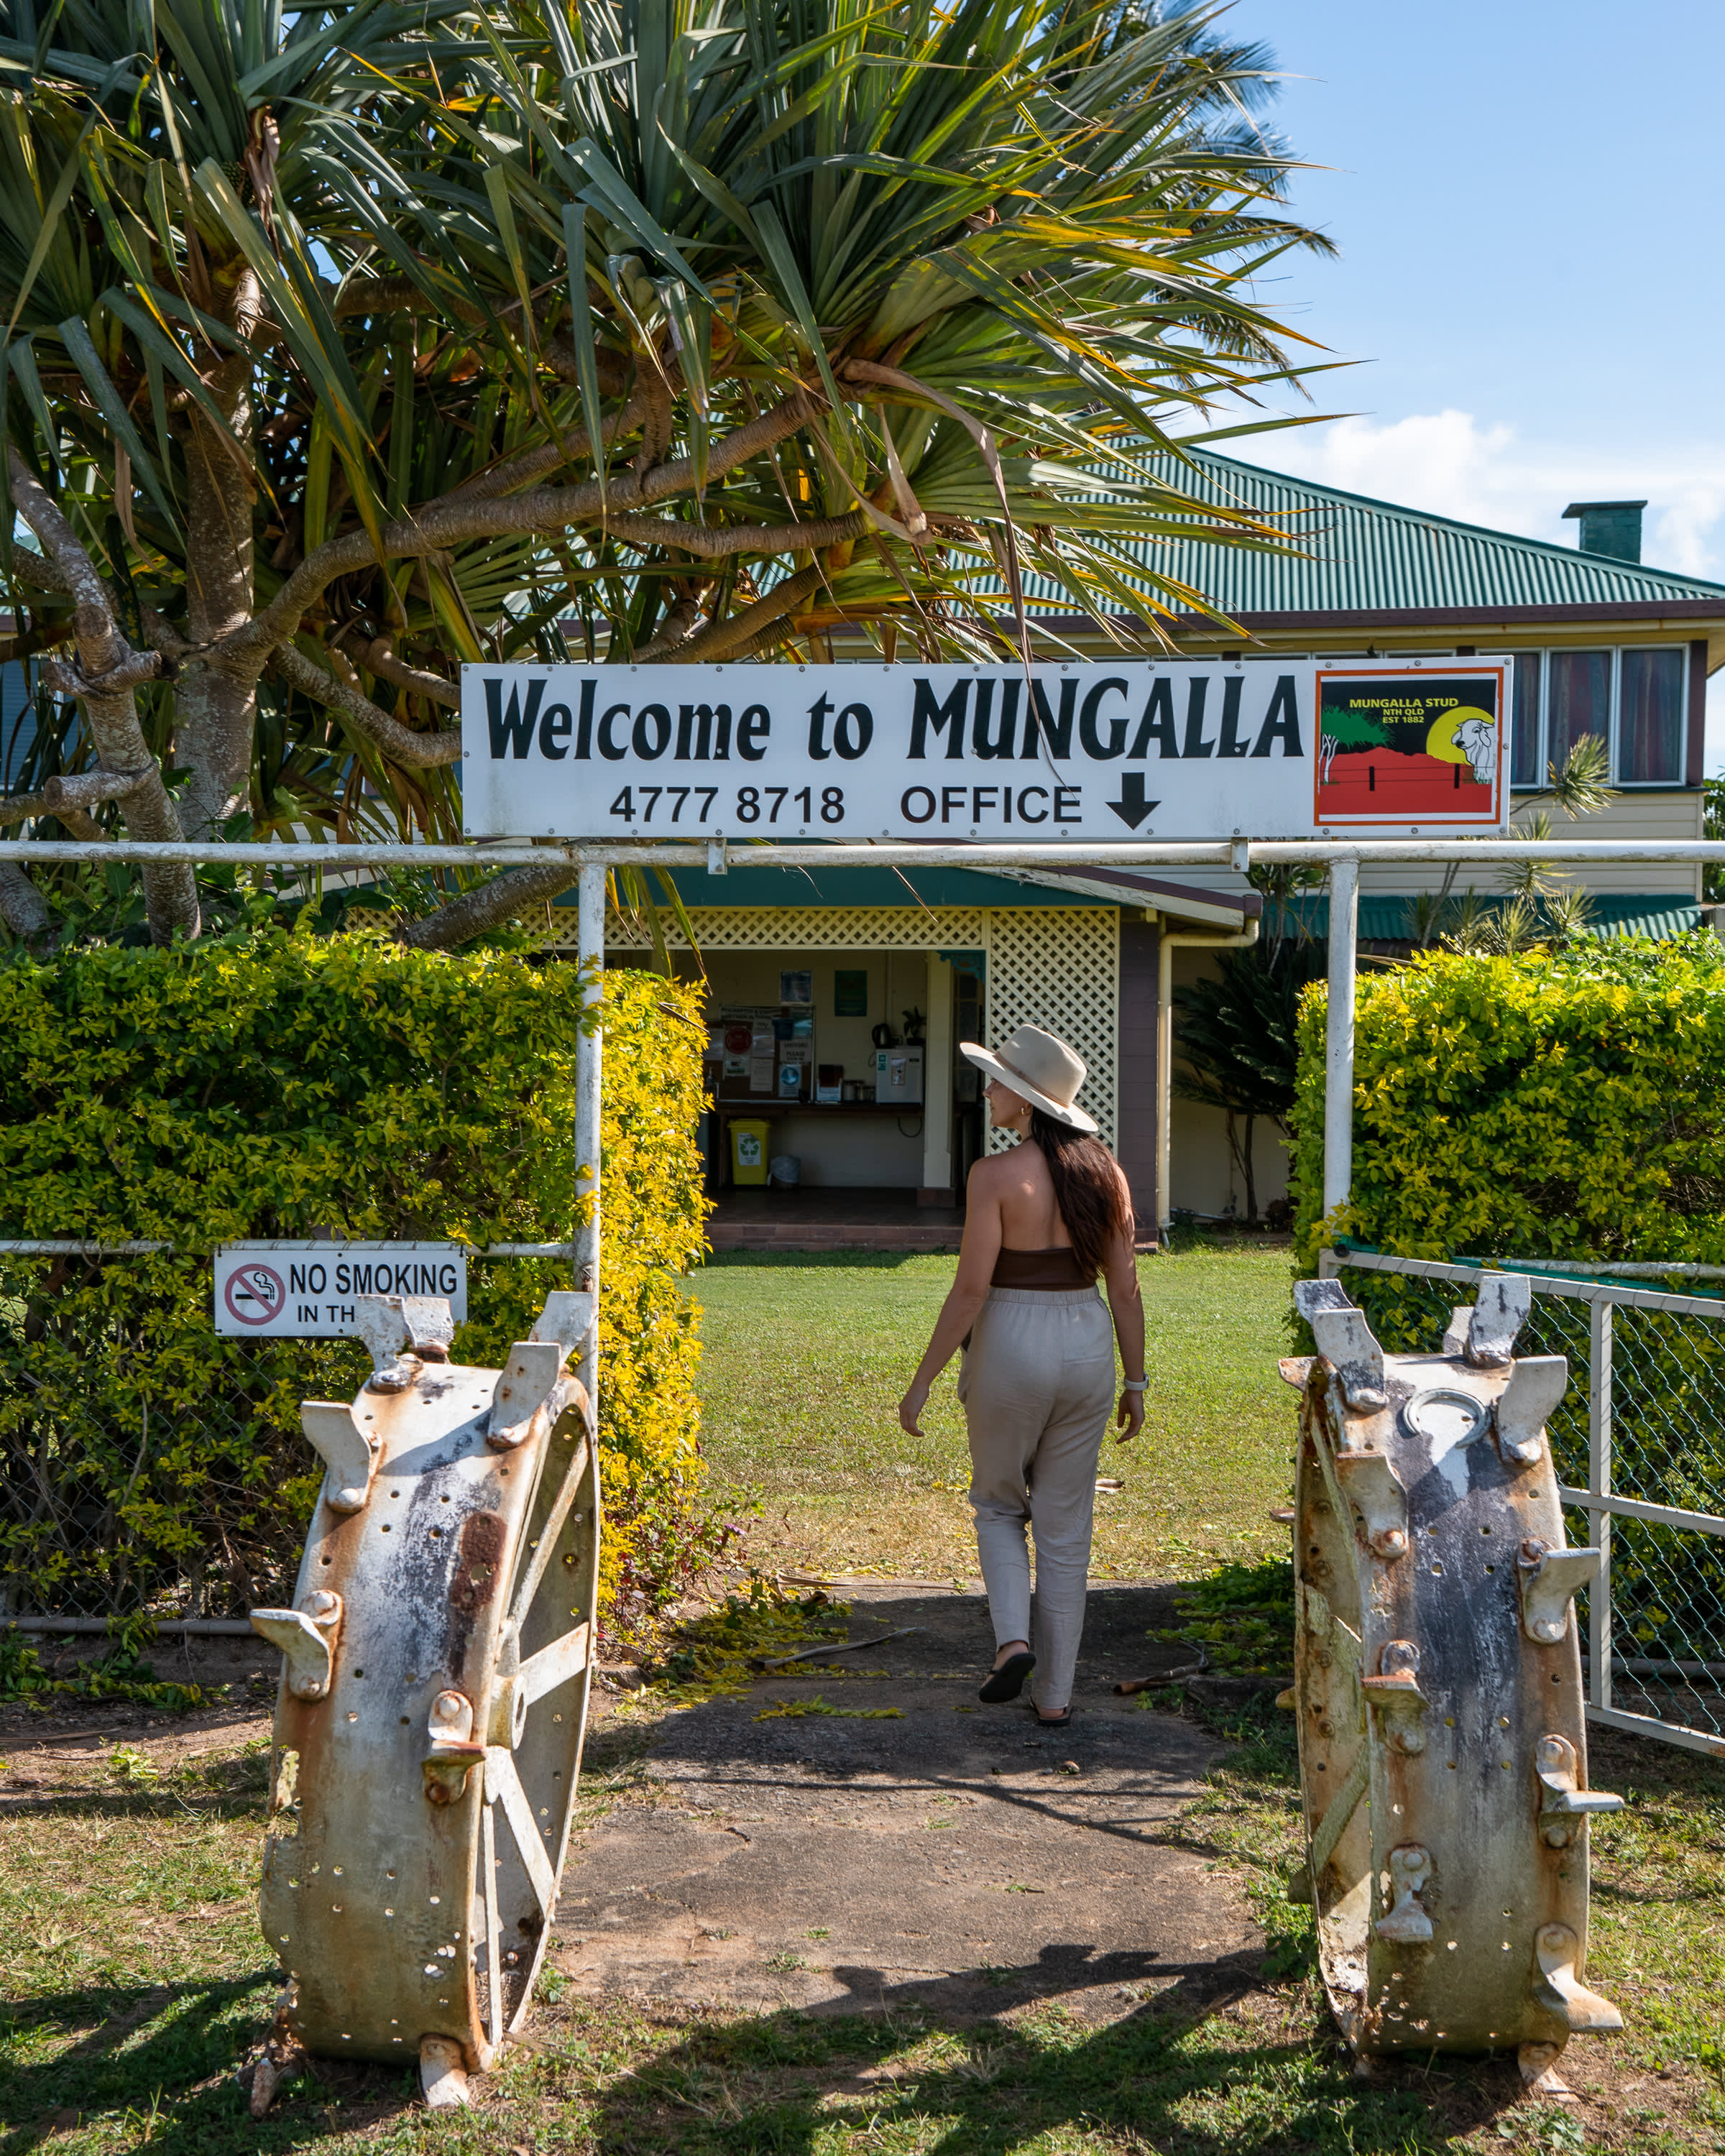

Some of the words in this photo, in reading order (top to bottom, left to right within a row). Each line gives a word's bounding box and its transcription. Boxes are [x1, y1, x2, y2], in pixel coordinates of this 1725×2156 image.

[1349, 698, 1422, 708] MUNGALLA
[1425, 698, 1459, 707] STUD
[1404, 708, 1425, 717] QLD
[482, 678, 771, 761] Welcome
[805, 690, 874, 760] to
[906, 675, 1305, 760] MUNGALLA
[610, 786, 719, 823] 4777
[736, 786, 845, 824] 8718
[901, 786, 1082, 824] OFFICE
[290, 1263, 327, 1295] NO
[335, 1263, 458, 1295] SMOKING
[298, 1304, 318, 1323] IN
[326, 1304, 355, 1323] TH
